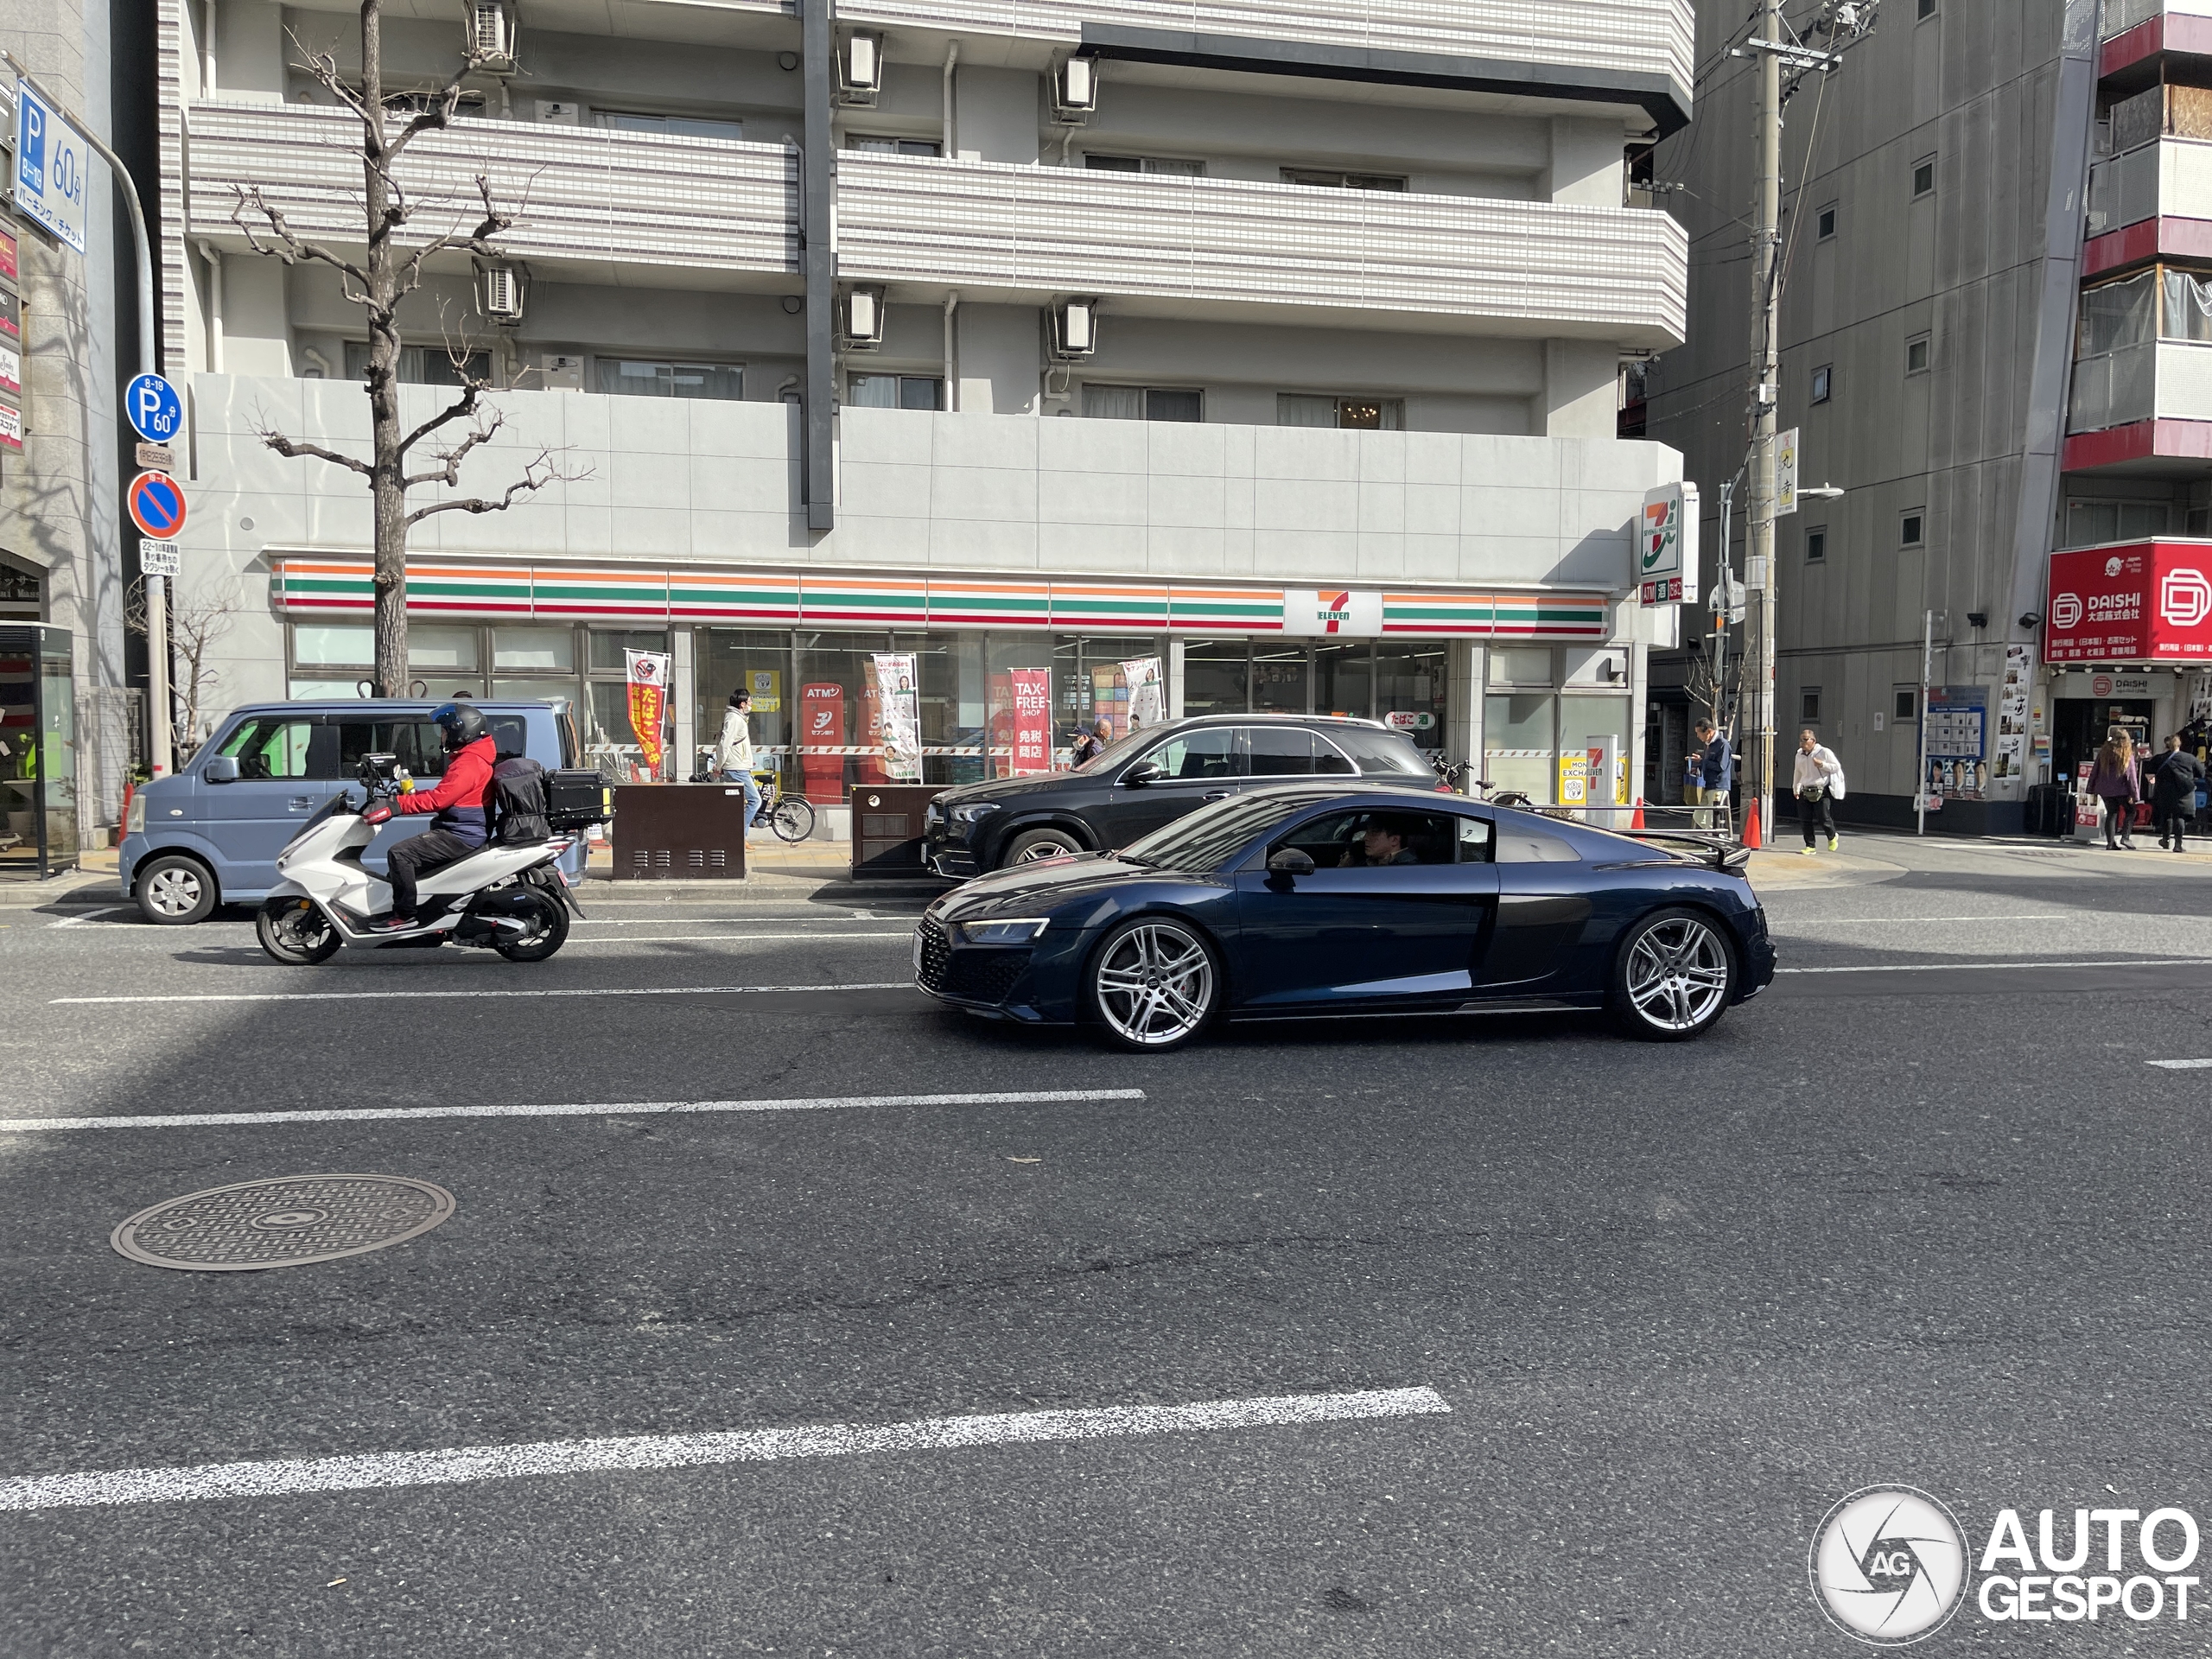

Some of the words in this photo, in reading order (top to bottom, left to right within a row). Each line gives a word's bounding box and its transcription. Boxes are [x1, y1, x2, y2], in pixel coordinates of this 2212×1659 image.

[28, 105, 41, 154] P
[19, 187, 83, 245] パーキング・チケット
[139, 387, 162, 429] P
[1643, 585, 1655, 601] ATM
[2088, 592, 2141, 610] DAISHI
[1015, 683, 1046, 695] TAX-
[2115, 679, 2148, 688] DAISHI
[807, 689, 830, 698] ATM
[1016, 696, 1046, 709] FREE
[1021, 709, 1041, 717] SHOP
[1391, 714, 1414, 725] たばこ
[1418, 714, 1429, 725] 酒
[1019, 729, 1043, 743] 免税
[1019, 745, 1043, 759] 商店
